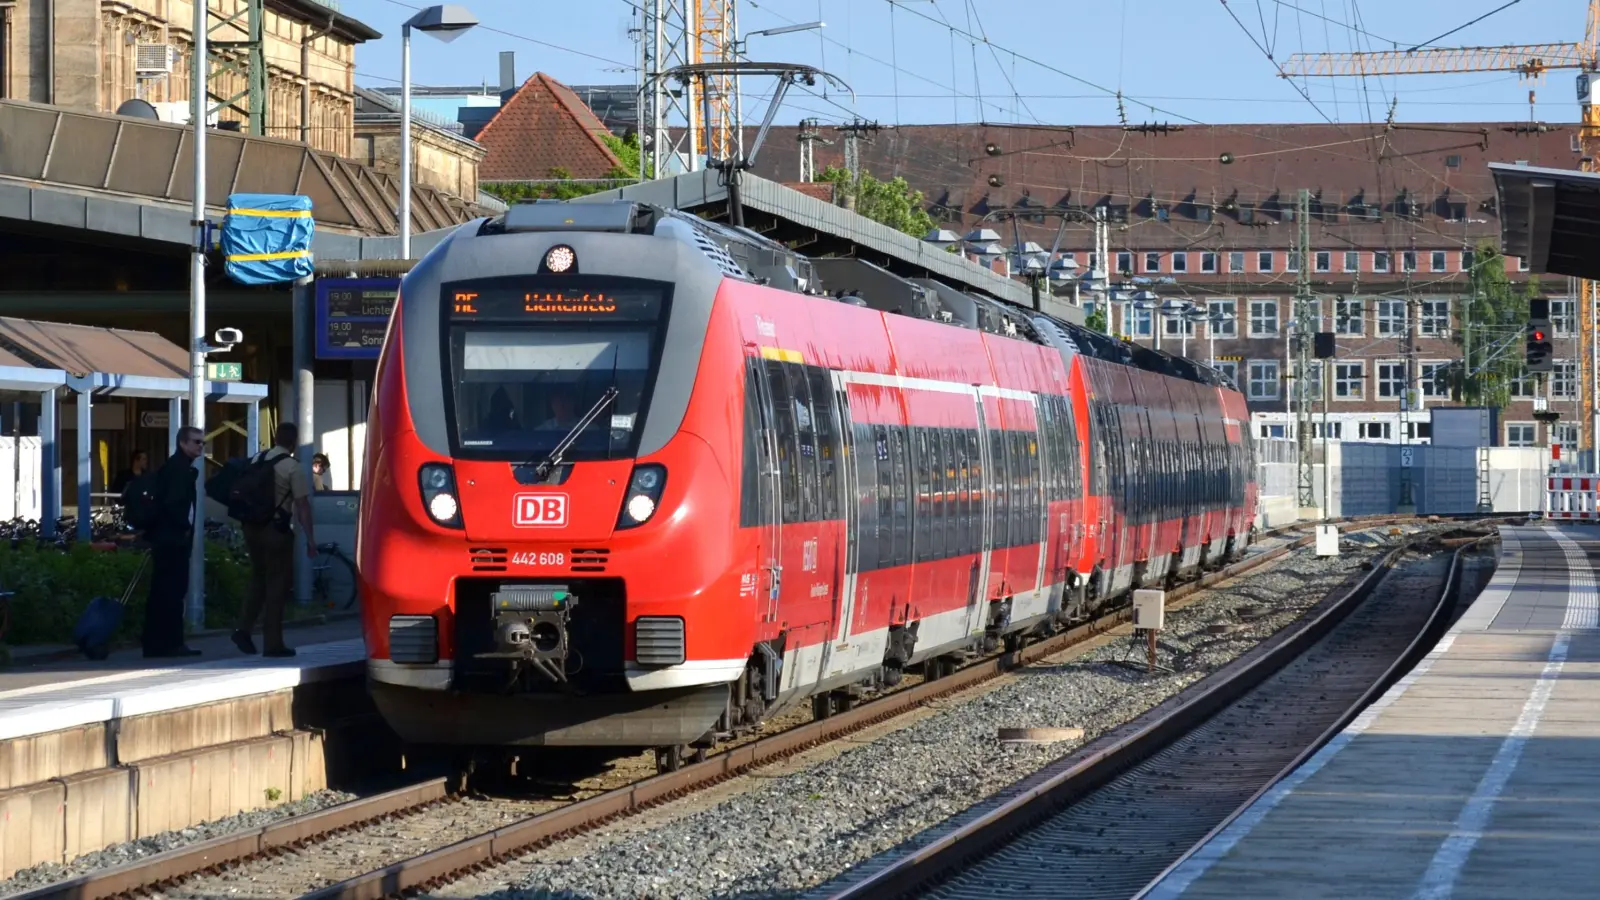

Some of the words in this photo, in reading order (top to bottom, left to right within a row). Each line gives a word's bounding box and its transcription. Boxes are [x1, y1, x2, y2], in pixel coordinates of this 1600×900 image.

[524, 293, 616, 312] Lichtenfels
[1402, 448, 1413, 457] 23
[1405, 456, 1410, 465] 2
[519, 497, 563, 522] DB
[512, 552, 537, 566] 442
[539, 552, 565, 566] 608
